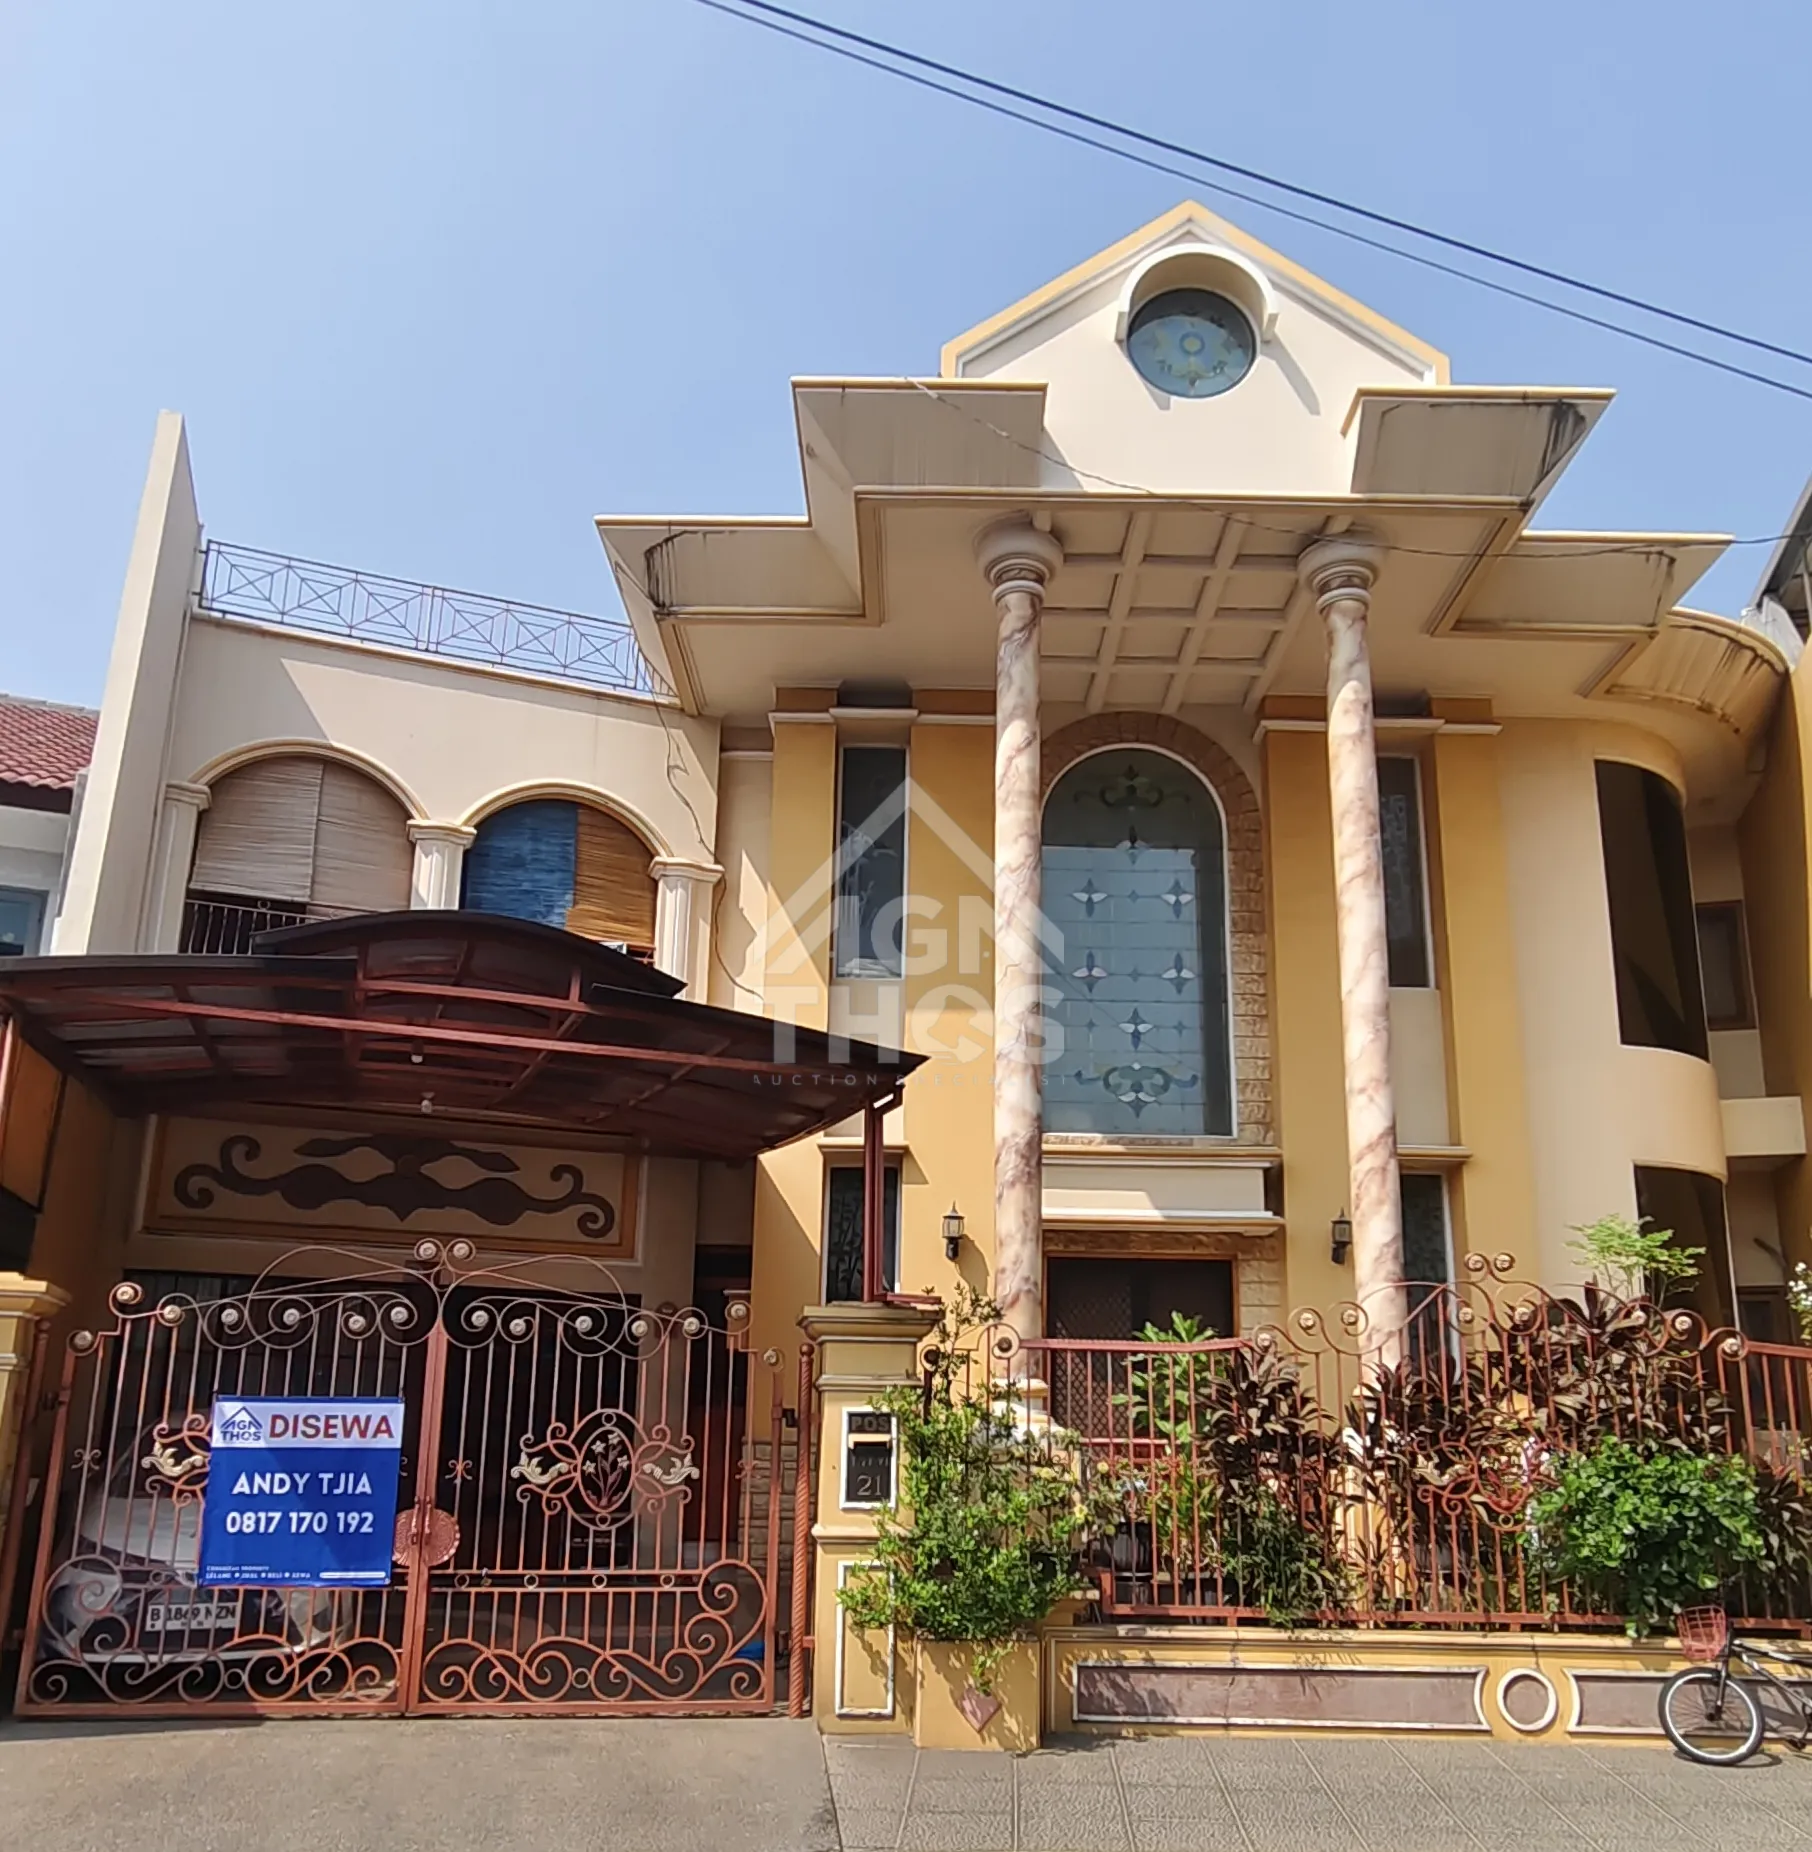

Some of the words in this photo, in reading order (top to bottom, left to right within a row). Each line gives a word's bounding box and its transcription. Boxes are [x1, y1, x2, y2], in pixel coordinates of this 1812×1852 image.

[269, 1414, 395, 1439] DISEWA
[851, 1416, 889, 1431] POS
[220, 1430, 262, 1441] THOS
[231, 1471, 311, 1495] ANDY
[318, 1471, 373, 1495] TJIA
[857, 1475, 882, 1496] 21
[226, 1511, 282, 1533] 0817
[288, 1511, 328, 1533] 170
[337, 1511, 374, 1533] 192
[150, 1607, 161, 1622] B
